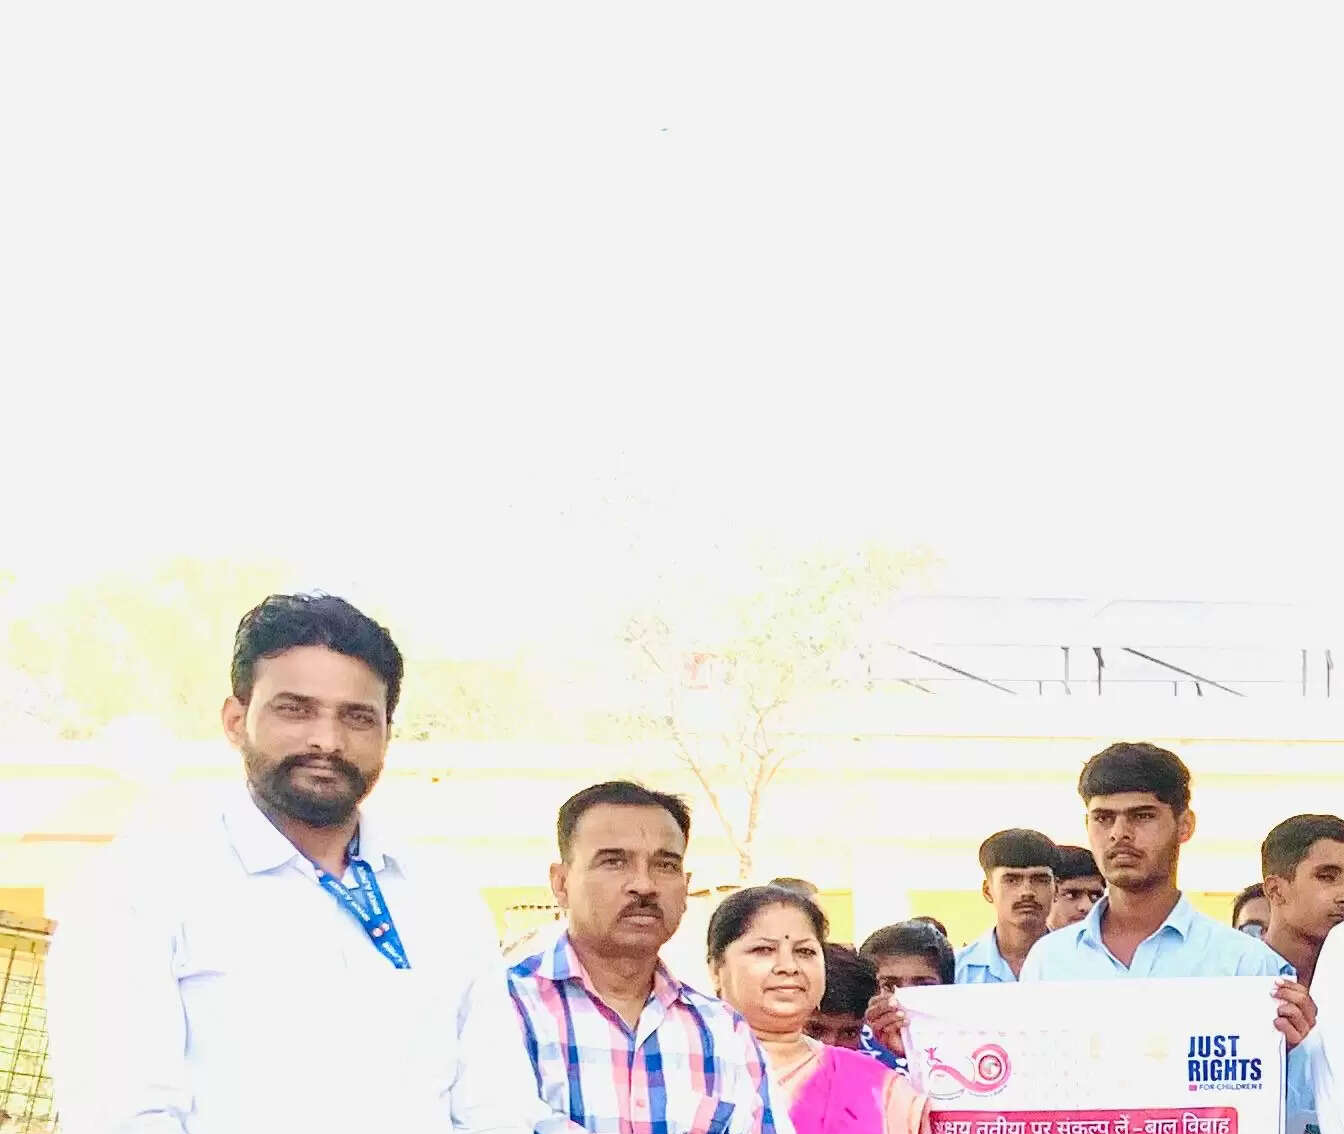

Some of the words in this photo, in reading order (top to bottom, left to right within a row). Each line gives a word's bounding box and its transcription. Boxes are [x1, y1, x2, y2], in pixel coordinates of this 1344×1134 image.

[1188, 1035, 1240, 1058] JUST
[1188, 1058, 1262, 1082] RIGHTS
[1199, 1083, 1215, 1091] FOR
[1216, 1083, 1258, 1091] CHILDREN
